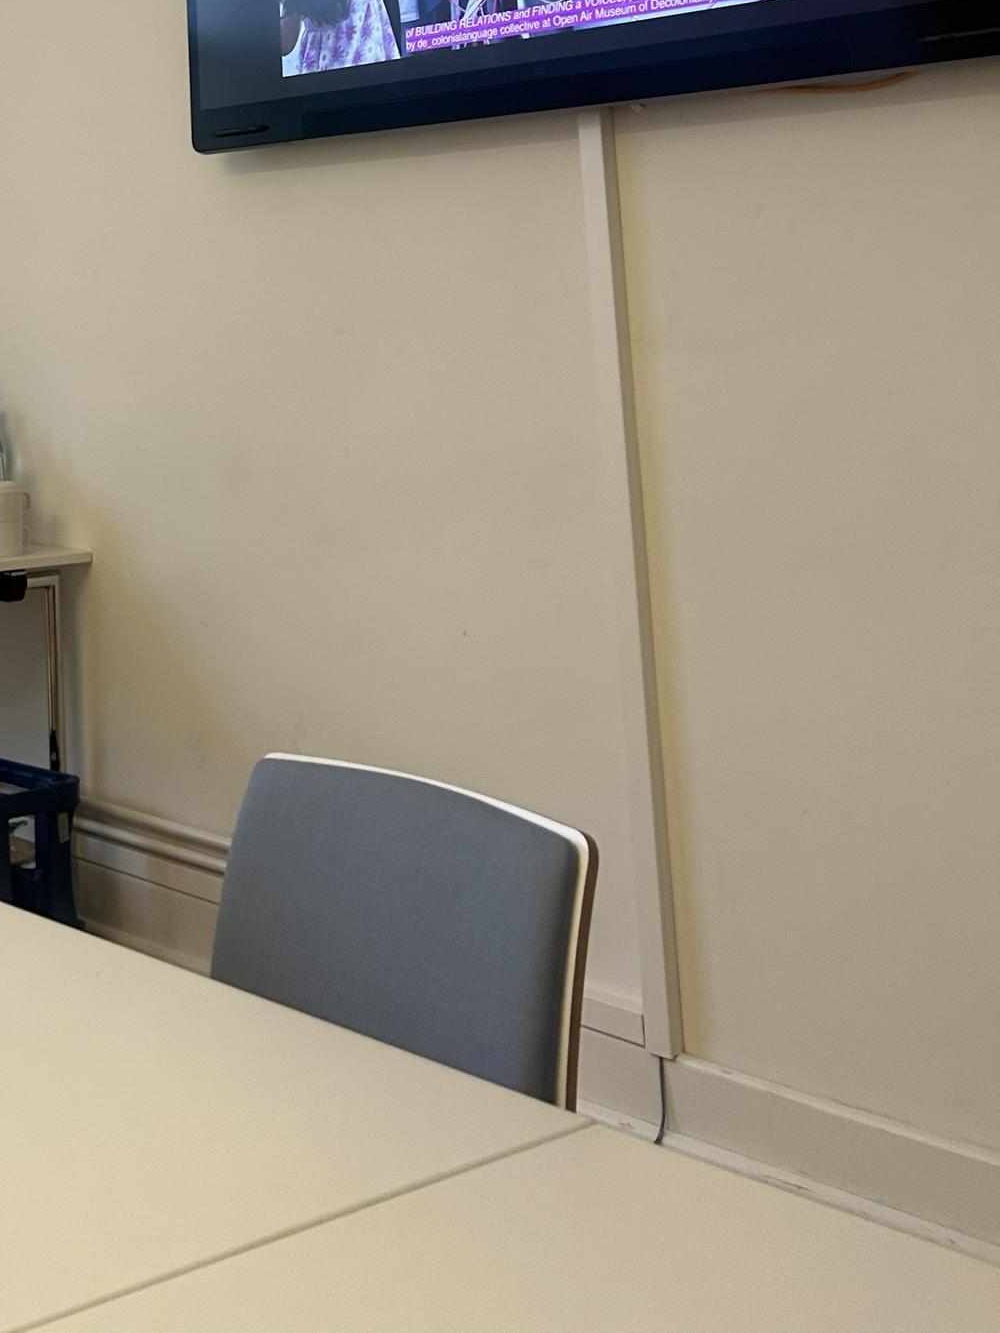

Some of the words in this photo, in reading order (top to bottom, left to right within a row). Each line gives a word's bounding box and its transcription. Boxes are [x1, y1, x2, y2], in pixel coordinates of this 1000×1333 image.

[405, 27, 415, 38] of
[415, 20, 457, 37] BUILDING
[460, 11, 512, 29] RELATIONS
[513, 8, 531, 20] and
[532, 0, 574, 17] FINDING
[575, 0, 582, 9] a
[405, 40, 416, 52] by
[500, 20, 540, 35] collective
[542, 18, 551, 28] at
[552, 13, 578, 28] Open
[580, 10, 593, 22] Air
[595, 4, 637, 20] Museum
[638, 0, 648, 12] of
